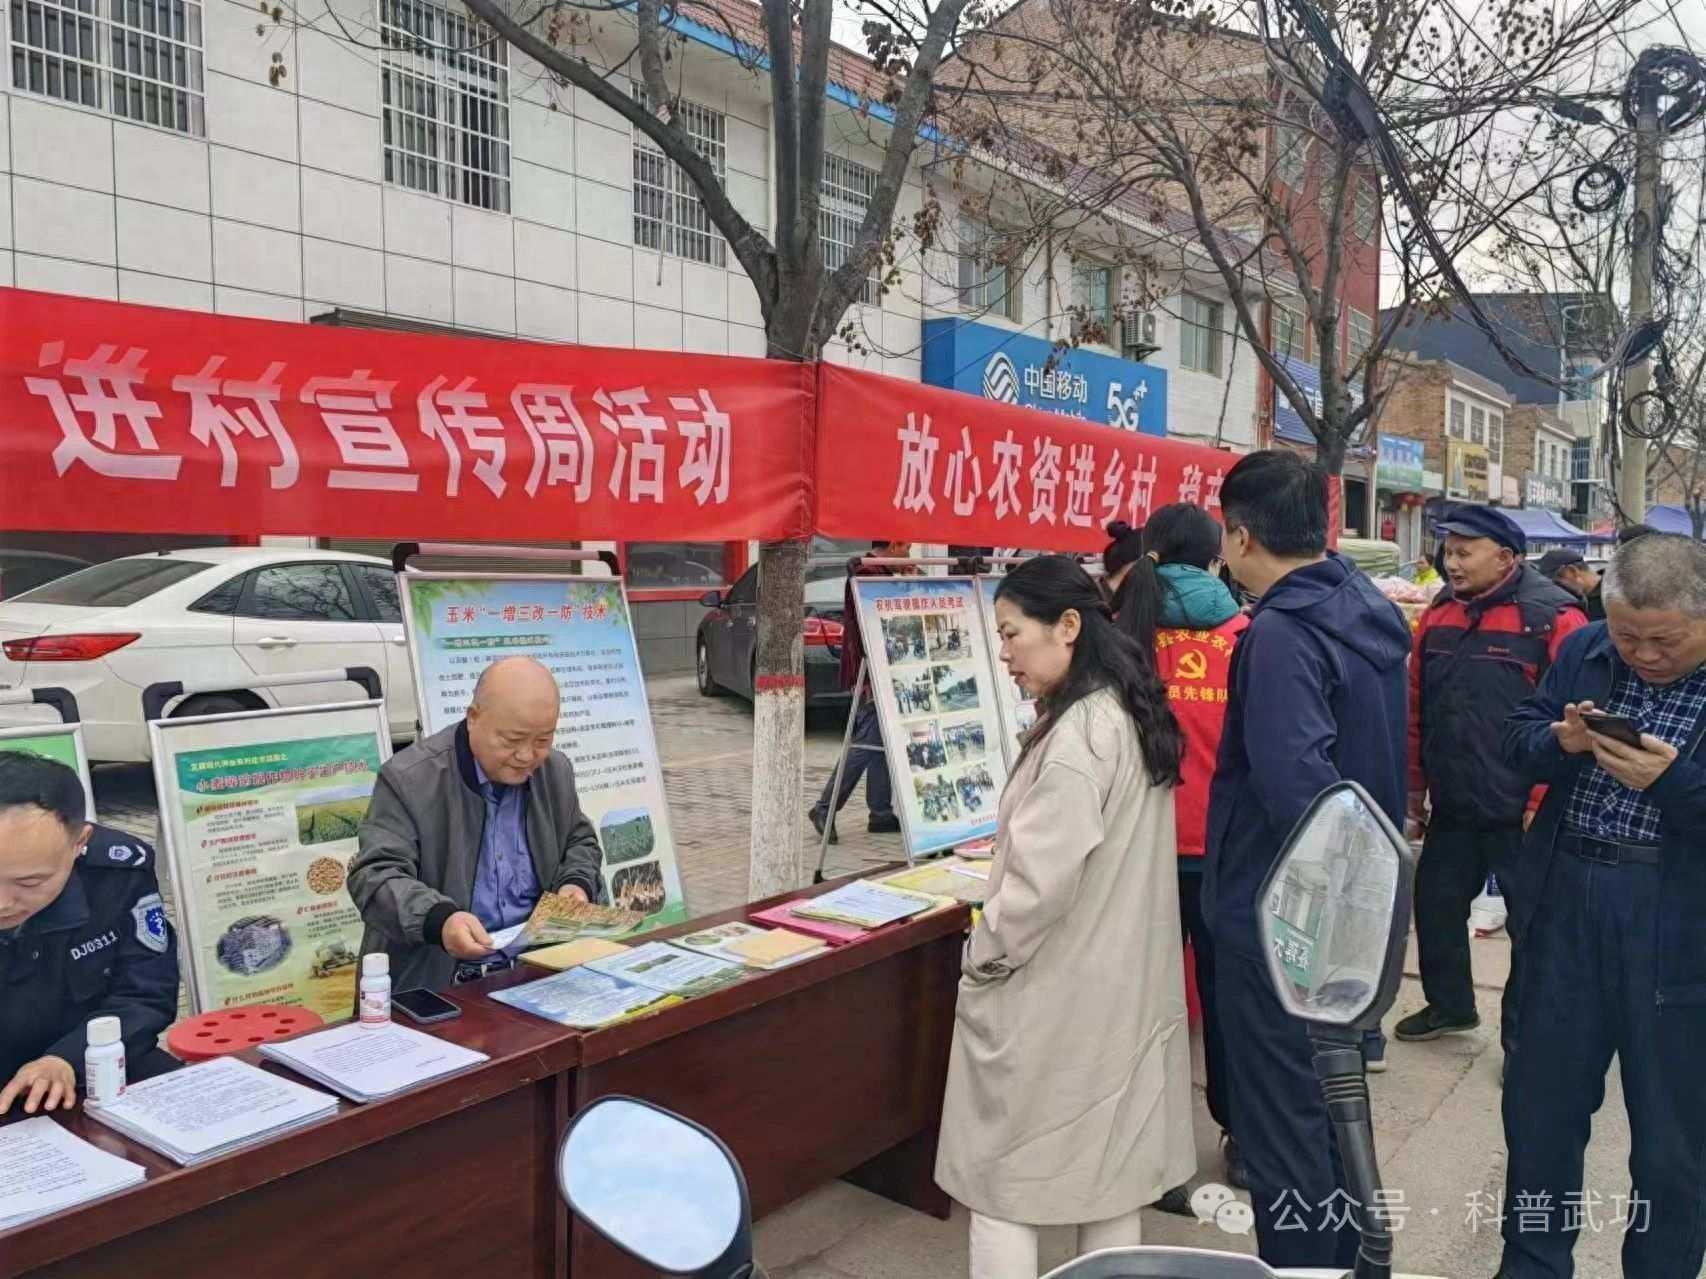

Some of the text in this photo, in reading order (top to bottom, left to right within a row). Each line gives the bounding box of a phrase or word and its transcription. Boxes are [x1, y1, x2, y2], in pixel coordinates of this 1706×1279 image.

[23, 340, 731, 505] 进村宣传周活动
[1024, 363, 1088, 404] 中国移动
[893, 412, 1158, 529] 放心农资进乡村
[70, 930, 118, 961] DJ0311
